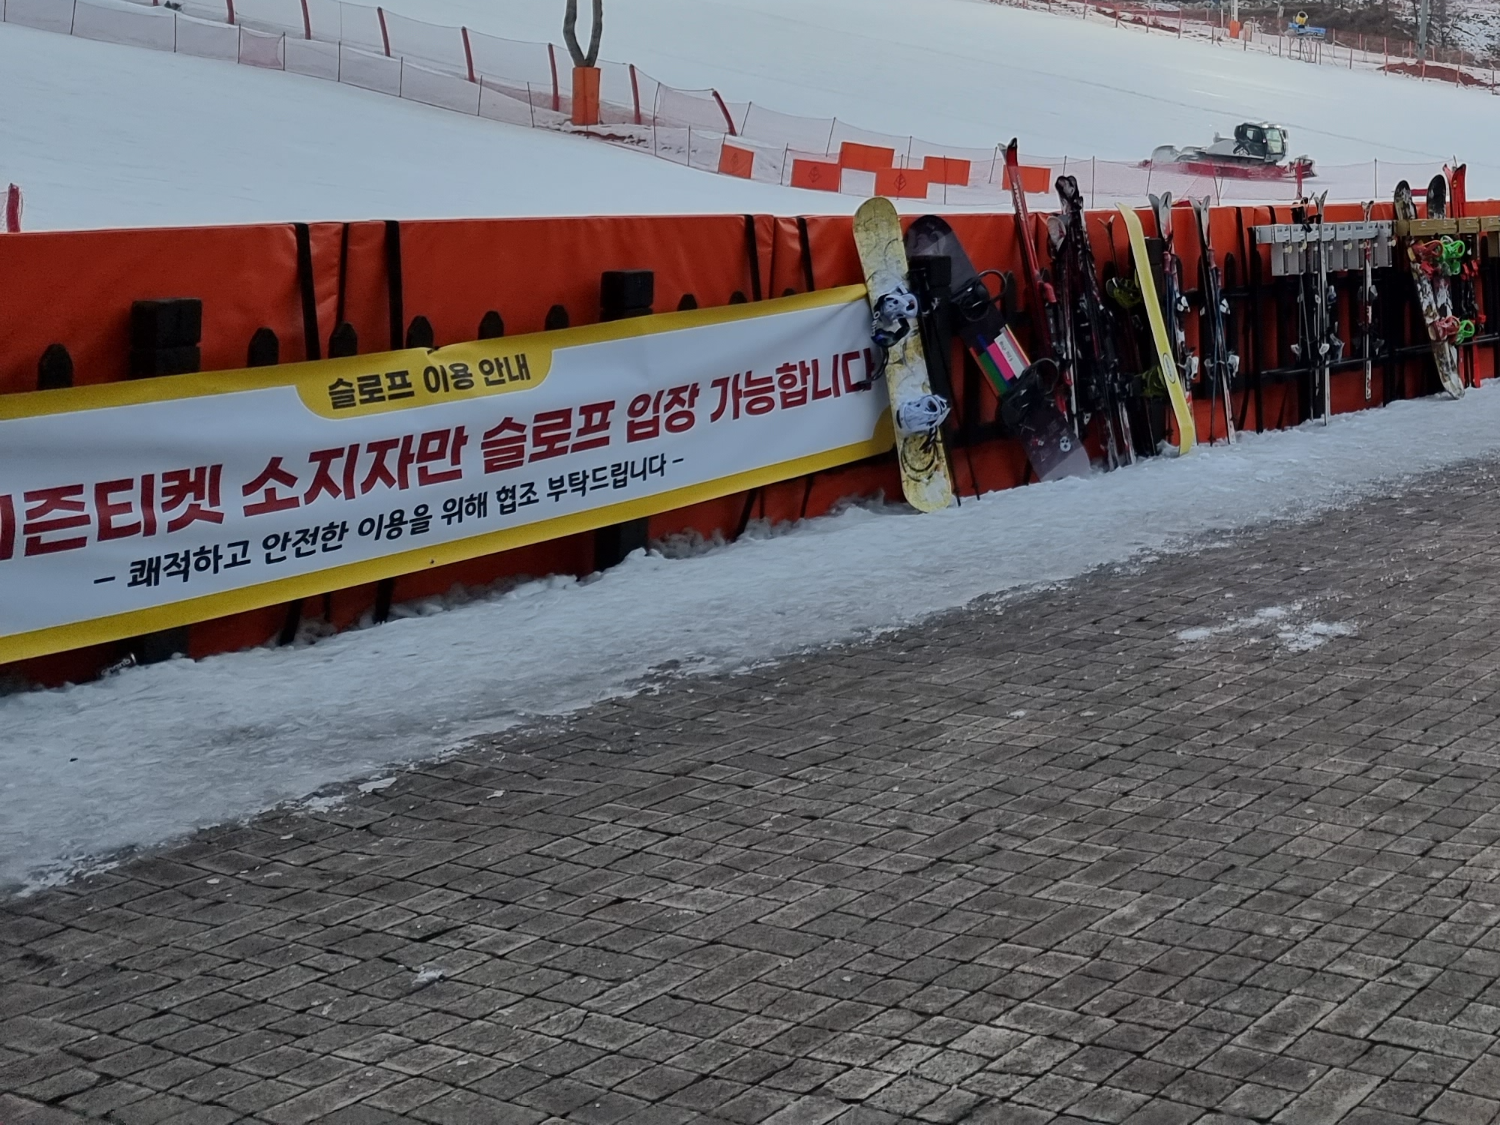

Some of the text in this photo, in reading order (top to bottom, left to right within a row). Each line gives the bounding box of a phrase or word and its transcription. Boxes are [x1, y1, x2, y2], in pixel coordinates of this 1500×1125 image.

[242, 424, 469, 518] 소지자만
[480, 400, 616, 475] 슬로프
[626, 382, 700, 444] 입장
[710, 348, 875, 424] 가능합니다
[328, 353, 531, 410] 슬로프 이용 안내
[127, 539, 252, 588] 쾌적하고
[261, 519, 349, 565] 안전한
[357, 503, 433, 543] 이용을
[440, 492, 489, 526] 위해
[496, 480, 540, 516] 협조
[546, 452, 668, 504] 부탁드립니다
